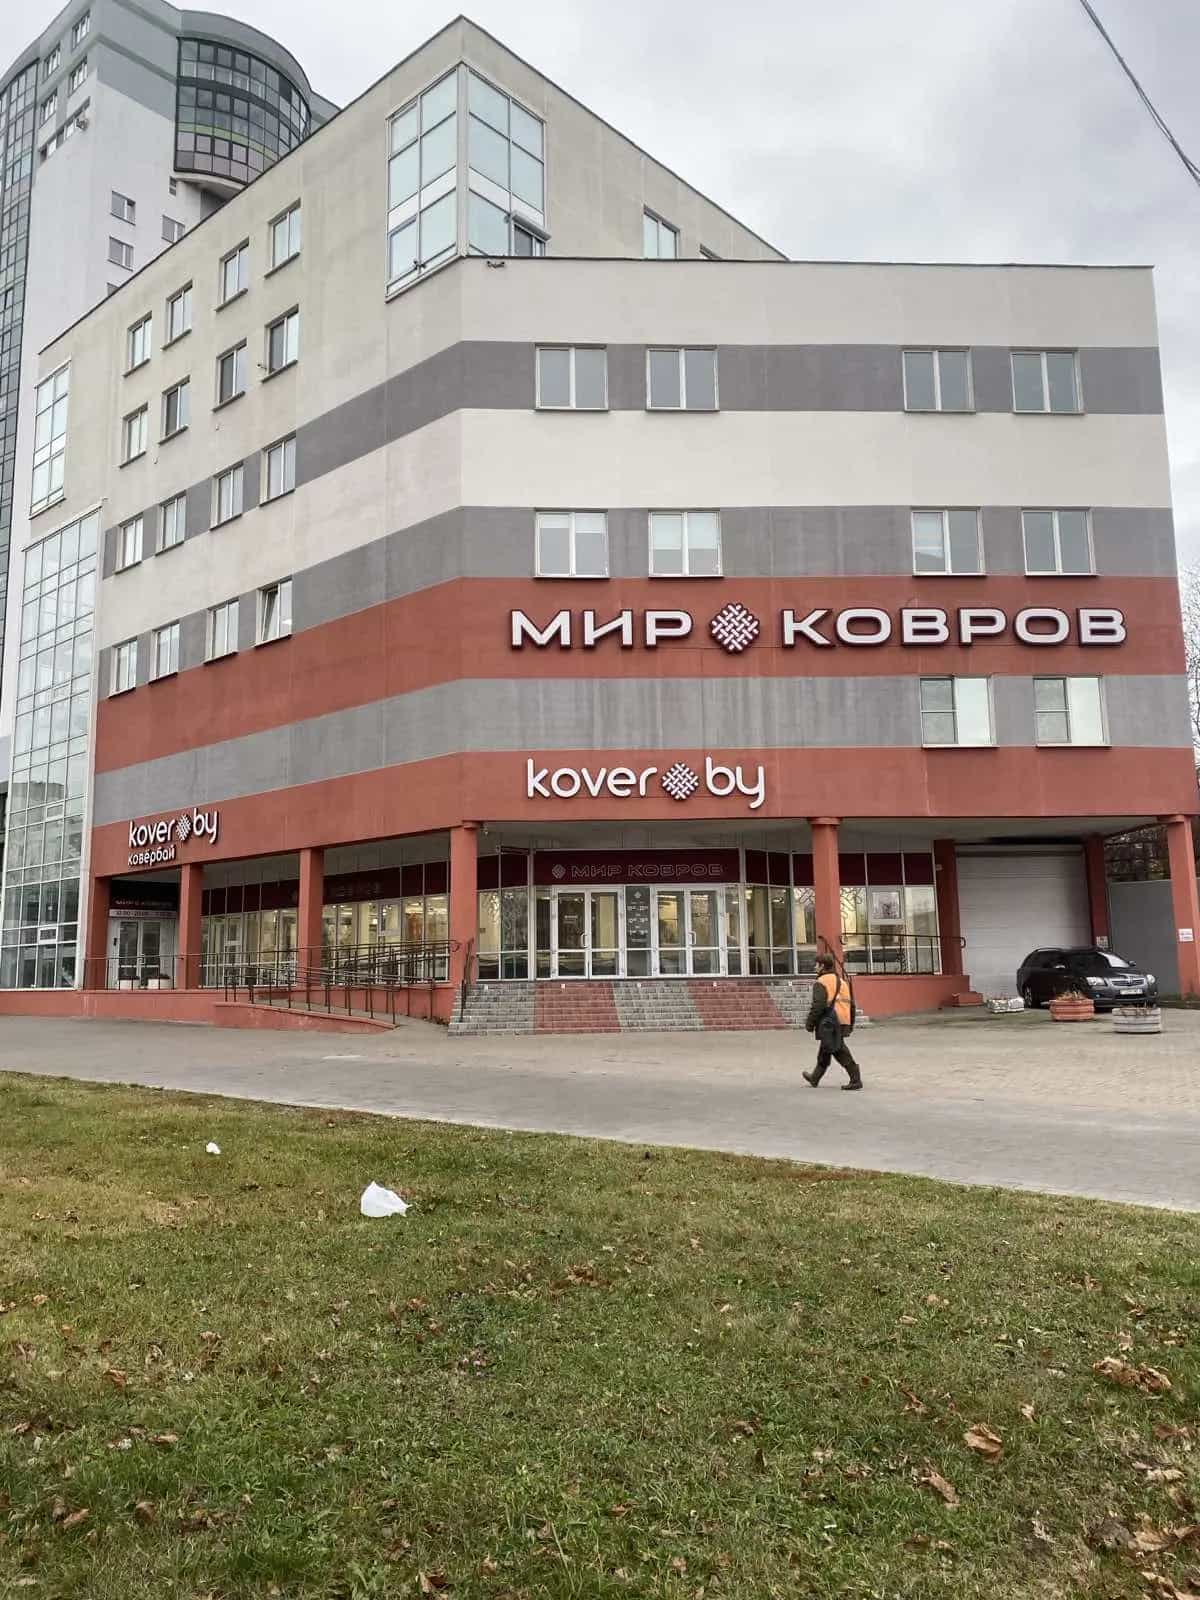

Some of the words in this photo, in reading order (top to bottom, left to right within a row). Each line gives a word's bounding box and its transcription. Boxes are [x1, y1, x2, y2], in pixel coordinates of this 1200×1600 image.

[510, 609, 694, 648] МИР
[781, 607, 1129, 648] КОВРОВ
[526, 758, 658, 799] kover
[704, 757, 766, 809] by
[128, 819, 176, 848] kover
[193, 807, 219, 844] by
[571, 864, 622, 877] МИР
[628, 864, 723, 876] КОВРОВ
